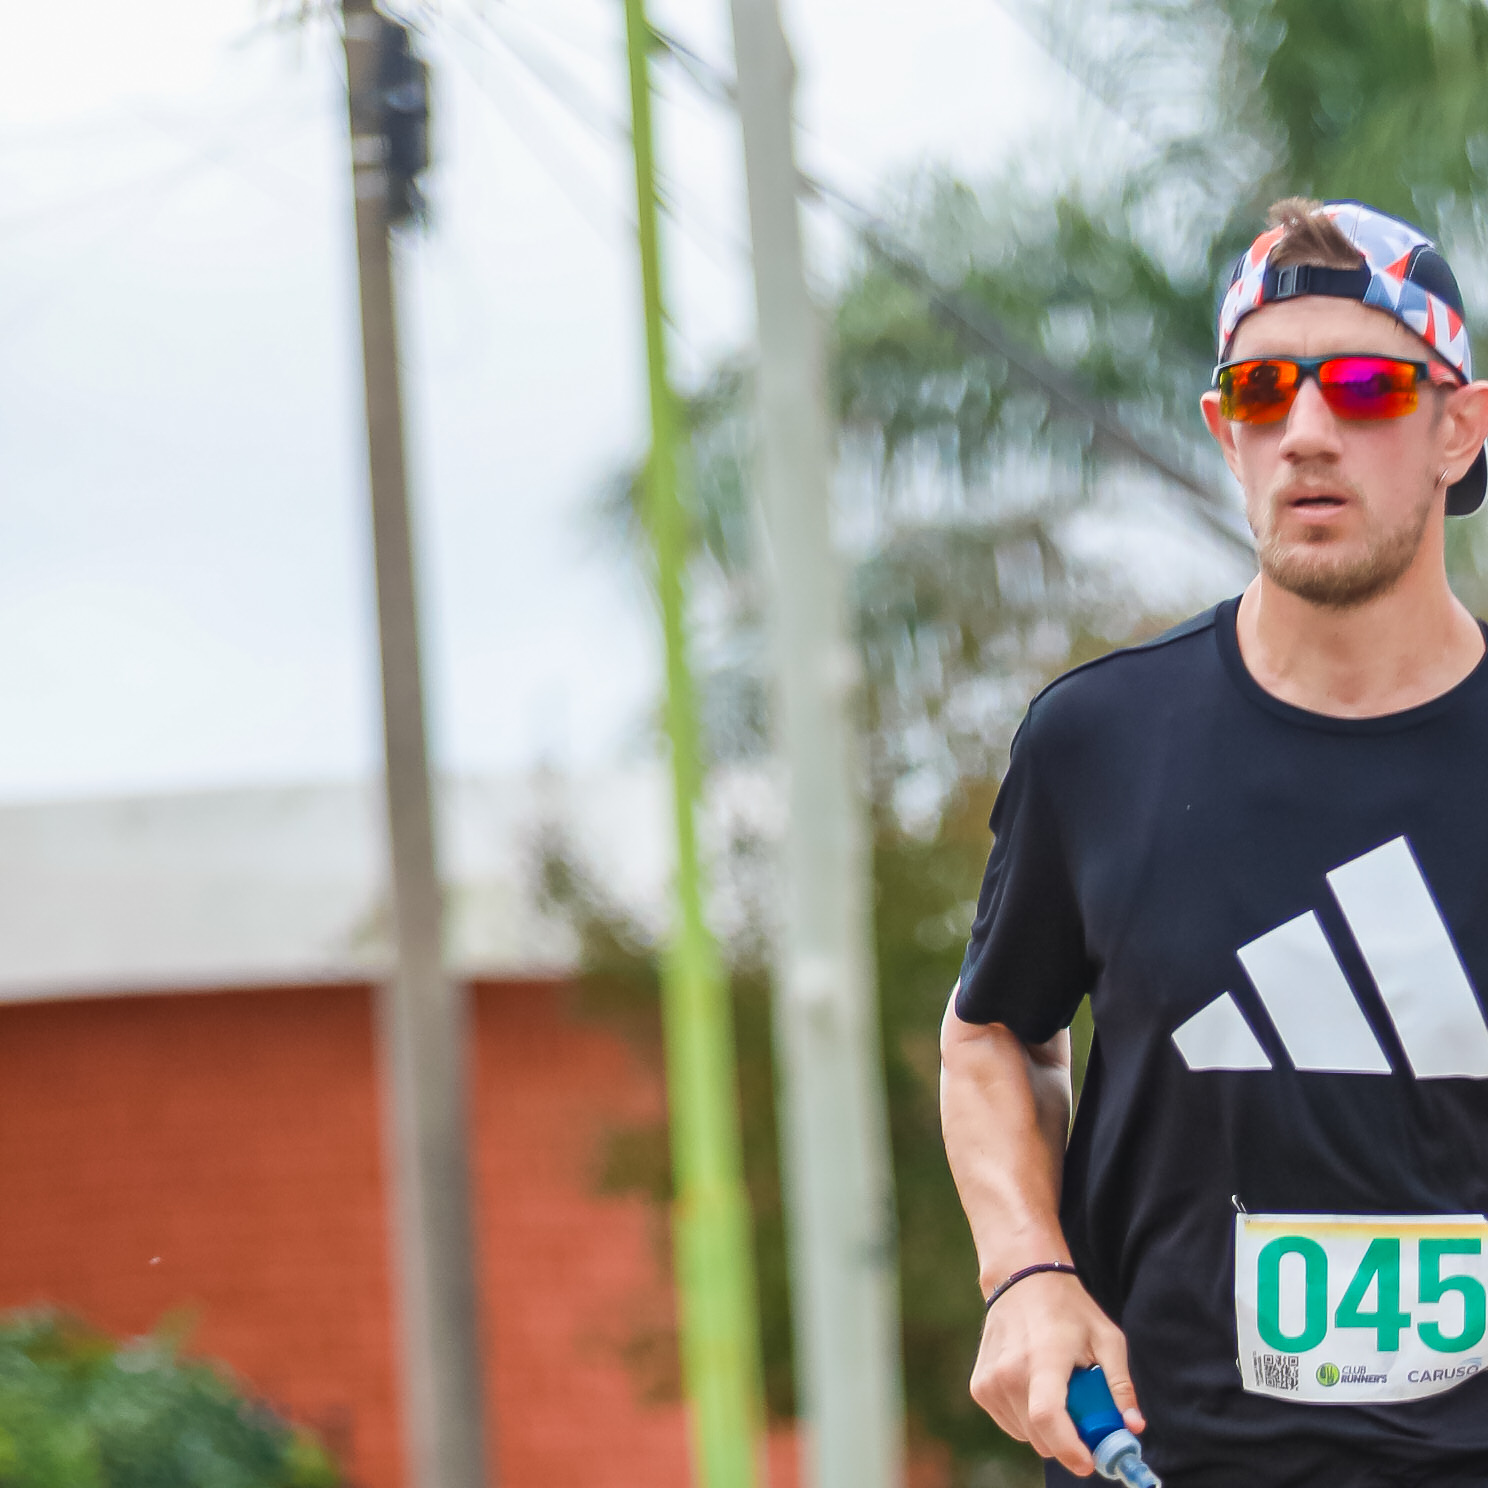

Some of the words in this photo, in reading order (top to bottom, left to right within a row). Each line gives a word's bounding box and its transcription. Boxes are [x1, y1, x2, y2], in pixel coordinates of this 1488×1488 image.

[1257, 1235, 1486, 1353] 045
[1341, 1365, 1367, 1375] CLUB
[1407, 1364, 1479, 1383] CARUSO
